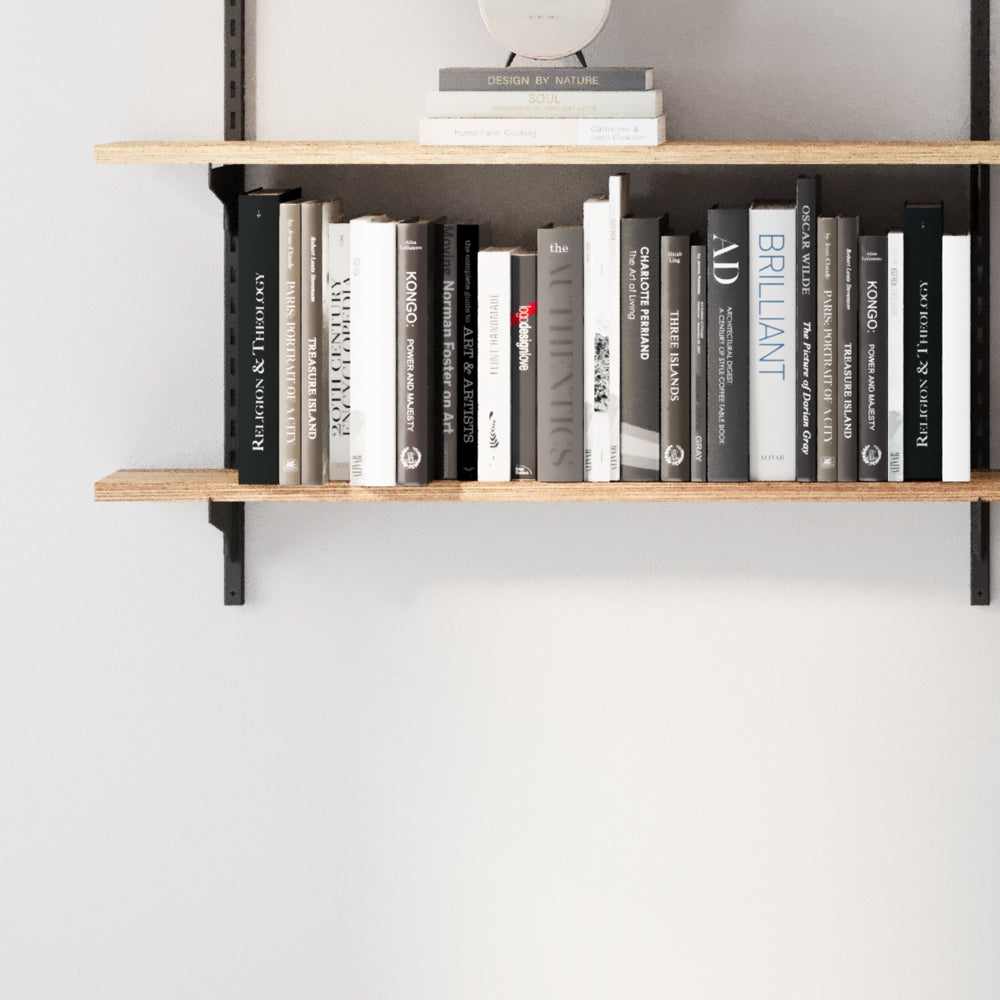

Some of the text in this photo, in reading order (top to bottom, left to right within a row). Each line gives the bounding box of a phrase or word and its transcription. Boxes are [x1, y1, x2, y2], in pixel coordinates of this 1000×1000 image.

[488, 76, 599, 84] DESIGN BY NATURE
[528, 93, 560, 103] SOUL
[549, 244, 568, 252] the
[713, 233, 739, 285] AD
[802, 206, 810, 295] OSCAR WILDE
[406, 271, 417, 327] KONGO:
[628, 294, 636, 320] Living
[629, 283, 636, 292] of
[640, 247, 649, 360] CHARLOTTE PERRIAND
[759, 234, 785, 380] BRILLIANT
[867, 281, 877, 334] KONGO:
[444, 225, 454, 434] Moving Norman Foster on Art
[465, 314, 471, 323] to
[489, 293, 499, 375] FLINT HANDMADE
[286, 321, 295, 380] PORTRAIT
[332, 279, 341, 436] 20TH CENTURY
[342, 278, 350, 436] ENCYCLOPEDIA
[463, 327, 474, 358] ART
[670, 310, 678, 401] THREE ISLANDS
[720, 345, 724, 354] OF
[824, 328, 832, 386] PORTRAIT
[252, 360, 264, 375] &
[463, 362, 474, 374] &
[550, 263, 574, 466] AUTHENTICS
[917, 362, 928, 379] &
[286, 384, 295, 400] OF
[802, 322, 811, 454] The Picture of Dorian Gray
[824, 388, 832, 404] OF
[286, 406, 295, 414] A
[286, 416, 295, 445] CITY
[463, 378, 474, 443] ARTISTS
[824, 417, 832, 443] CITY
